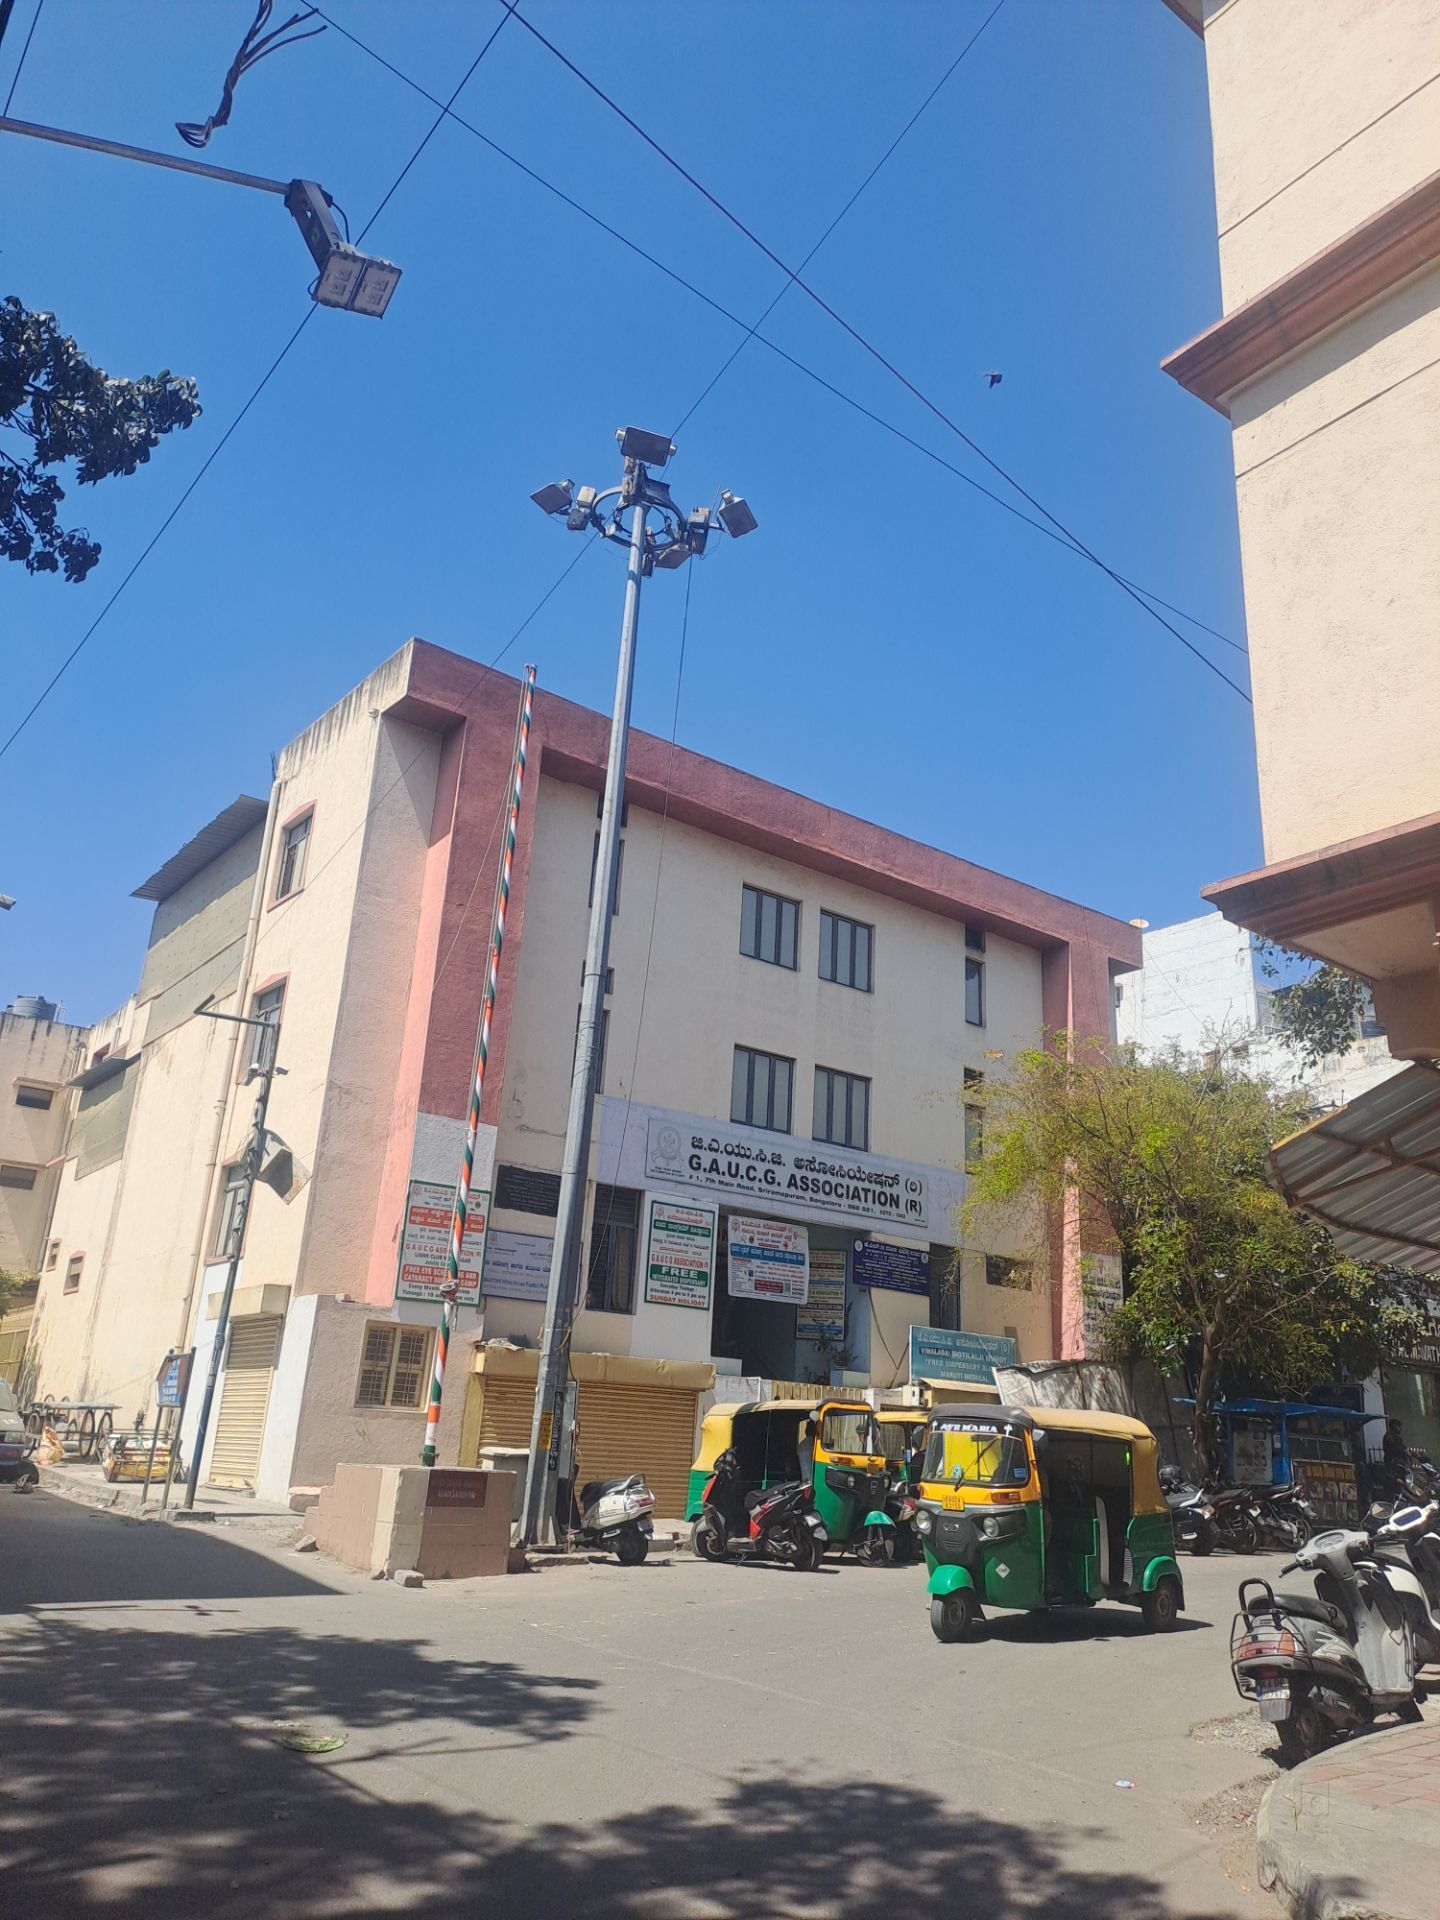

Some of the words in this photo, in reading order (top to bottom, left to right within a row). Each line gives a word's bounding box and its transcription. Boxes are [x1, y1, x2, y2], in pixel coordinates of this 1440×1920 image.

[688, 1154, 781, 1187] G.A.U.C.G.
[787, 1173, 900, 1209] ASSOCIATION
[905, 1199, 922, 1216] (R)
[718, 1179, 735, 1188] Main
[809, 1196, 842, 1208] Bangalore
[673, 1257, 703, 1269] ASSOCIATION
[405, 1265, 420, 1274] FREE
[661, 1266, 698, 1279] FREE
[403, 1273, 433, 1283] CATARACT
[650, 1294, 676, 1303] SUNDAY
[678, 1298, 706, 1307] HOLIDAY
[962, 1424, 998, 1433] MARIA
